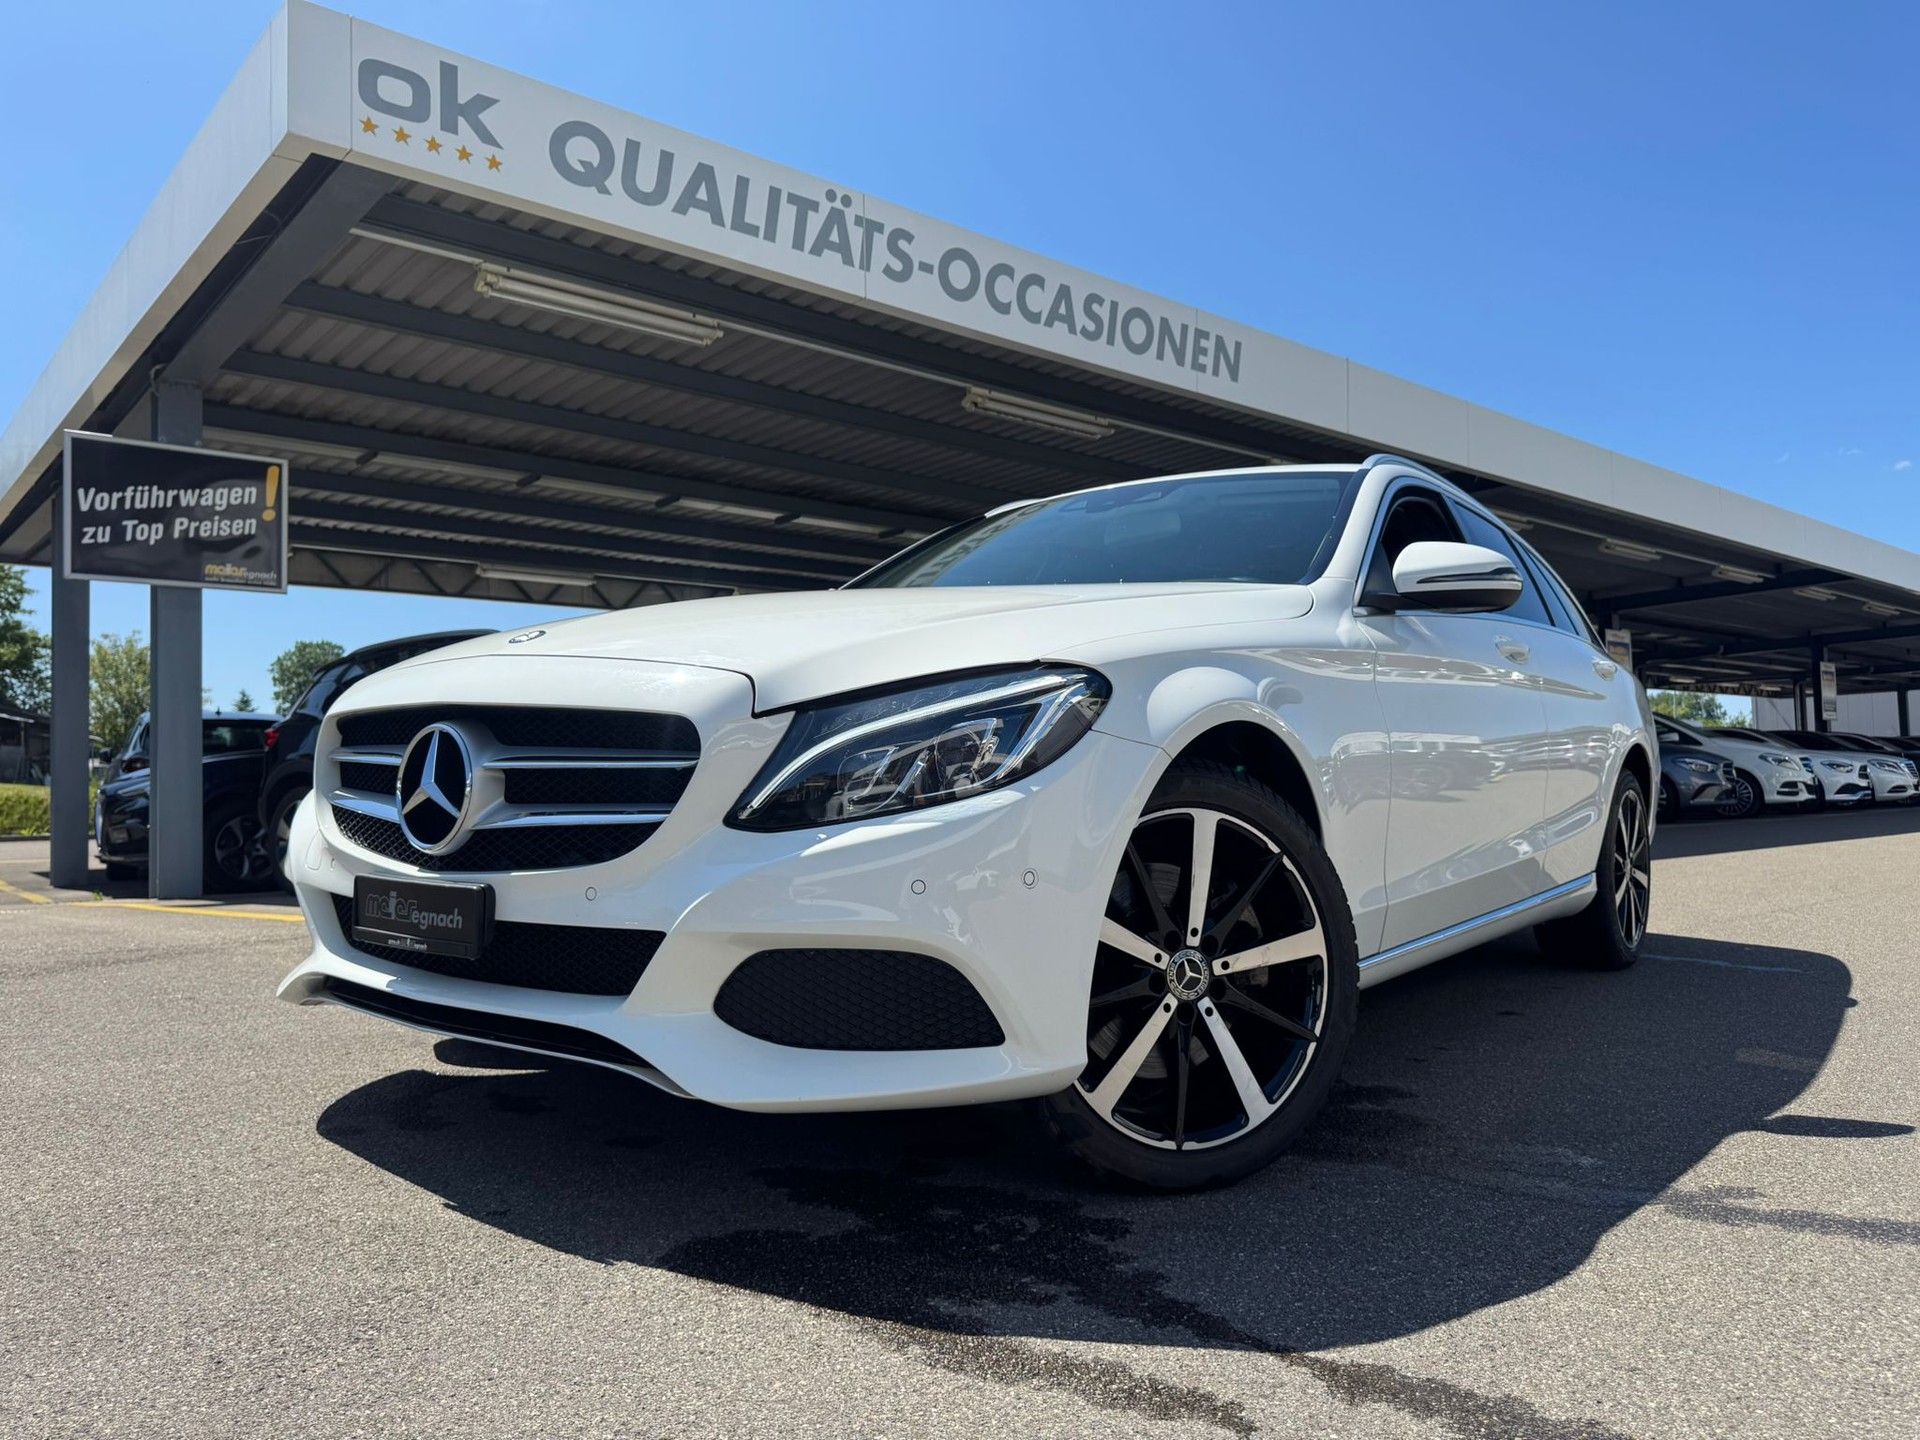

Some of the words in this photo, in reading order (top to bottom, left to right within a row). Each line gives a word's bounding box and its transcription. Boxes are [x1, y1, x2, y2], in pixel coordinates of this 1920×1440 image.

[358, 58, 504, 150] ok
[549, 120, 1242, 383] QUALITÄTS-OCCASIONEN
[77, 485, 257, 512] Vorführwagen
[81, 525, 111, 544] zu
[122, 519, 164, 545] Top
[173, 516, 257, 539] Preisen
